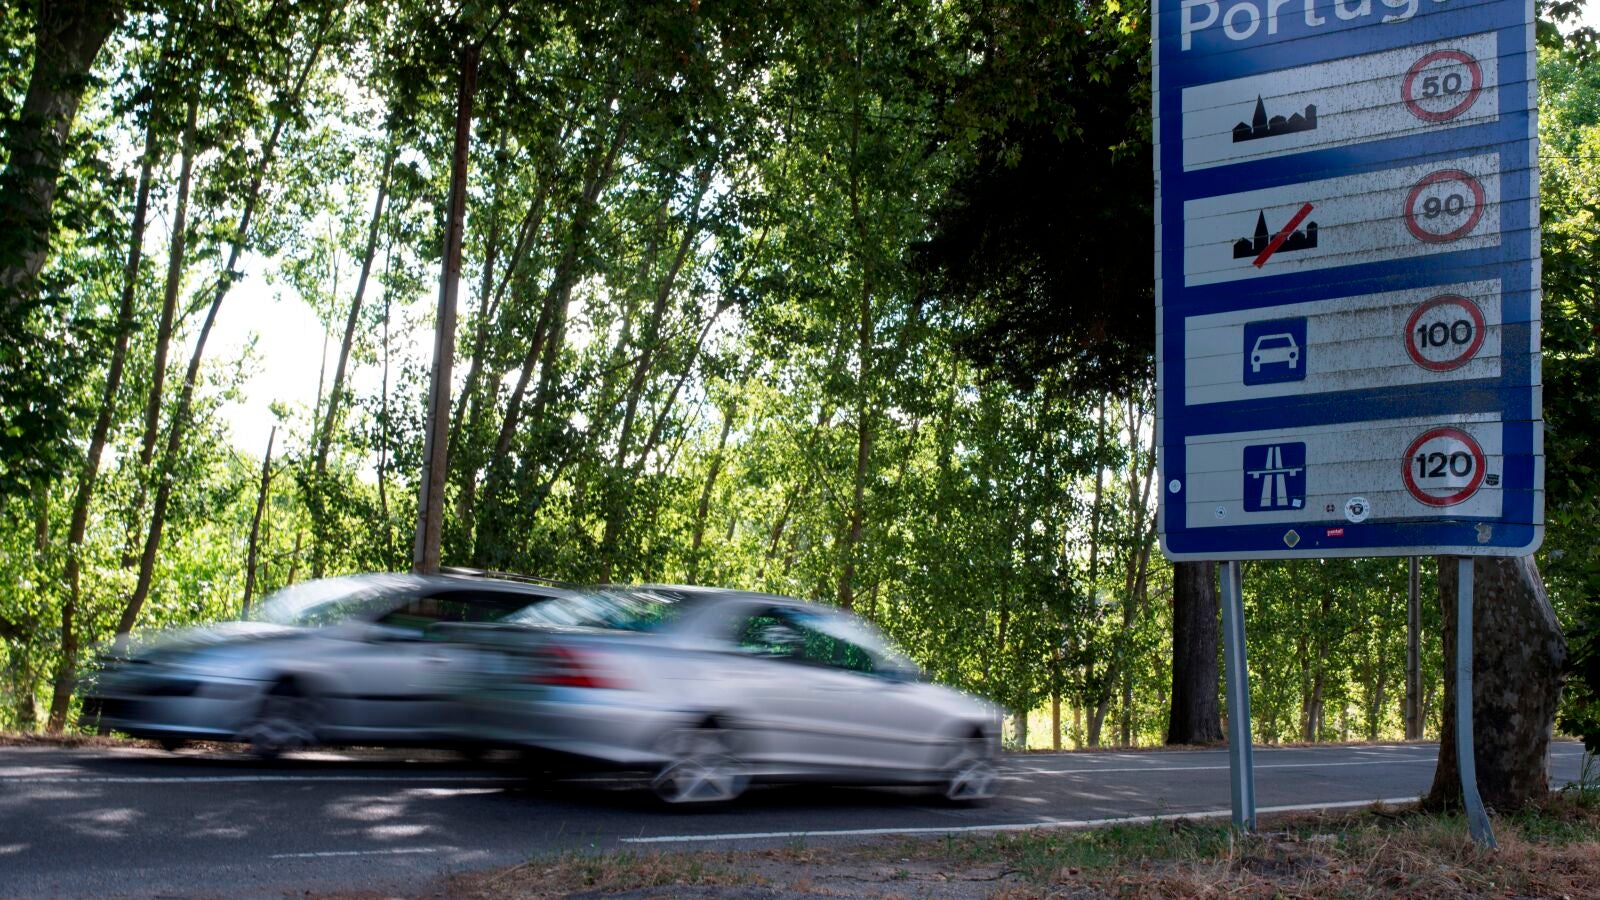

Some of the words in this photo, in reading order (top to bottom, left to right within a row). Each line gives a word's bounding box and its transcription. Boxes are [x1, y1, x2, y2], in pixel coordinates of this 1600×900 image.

[1422, 73, 1462, 98] 50
[1423, 194, 1464, 219] 90
[1417, 319, 1472, 348] 100
[1416, 451, 1472, 478] 120
